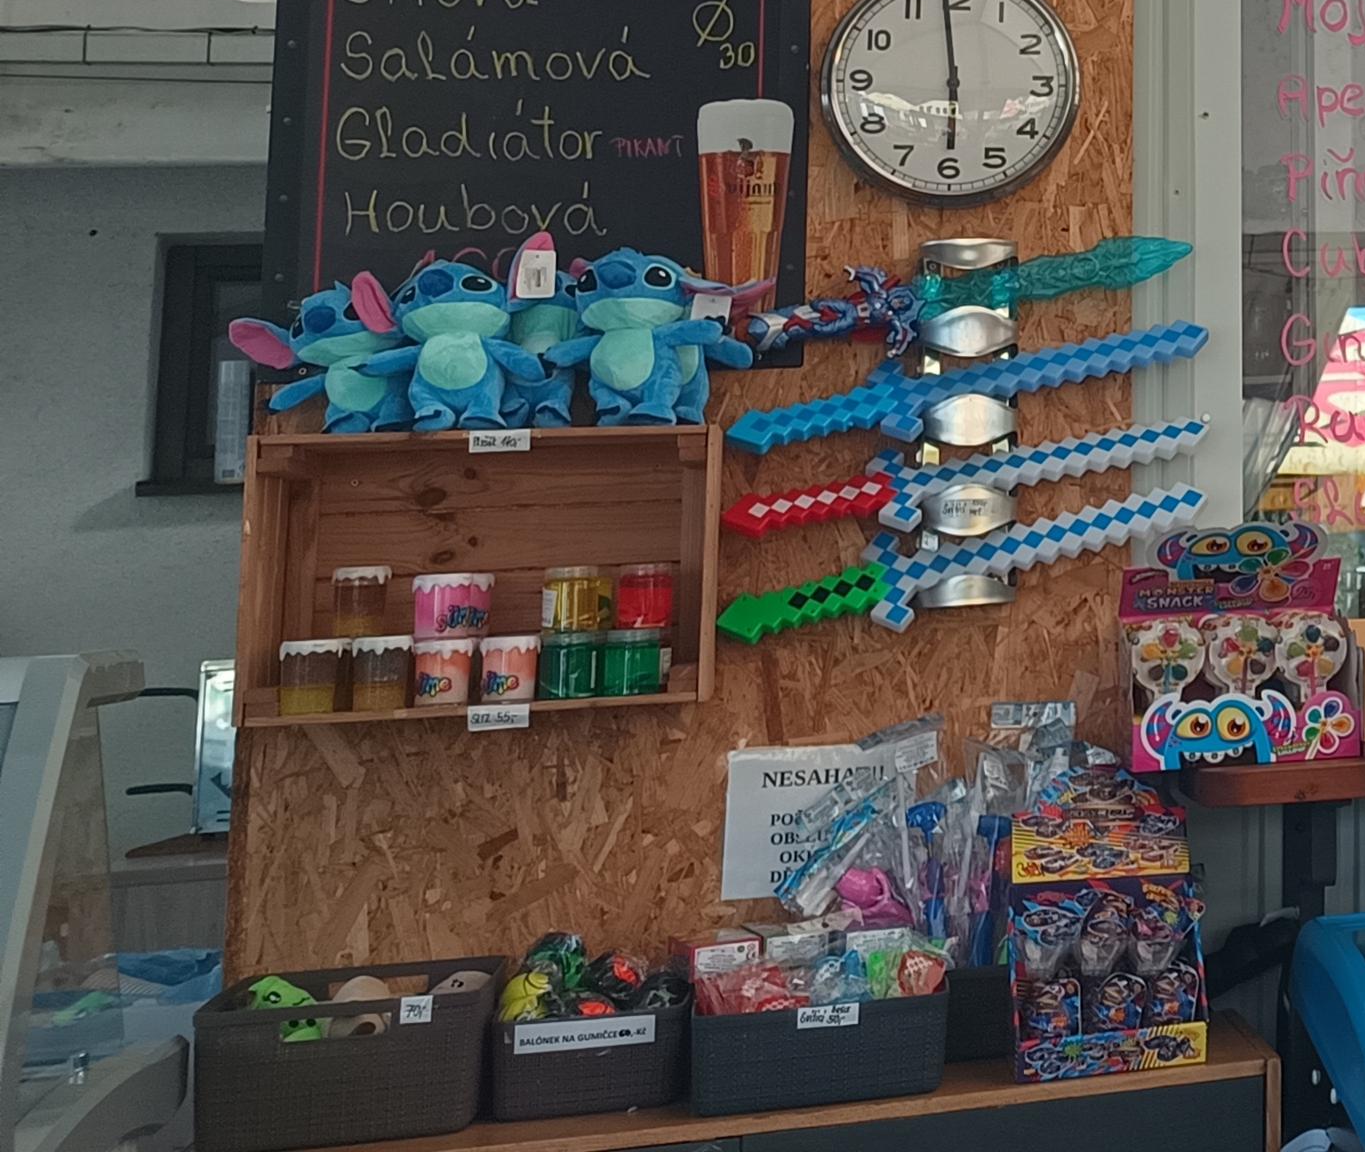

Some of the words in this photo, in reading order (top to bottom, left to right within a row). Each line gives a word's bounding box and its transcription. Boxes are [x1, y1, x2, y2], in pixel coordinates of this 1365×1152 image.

[867, 28, 891, 51] 10
[1018, 33, 1042, 55] 2
[340, 25, 650, 82] Salámová
[849, 69, 873, 91] 9
[1029, 75, 1054, 97] 3
[336, 98, 603, 161] Gladiátor
[609, 134, 684, 160] PIKANT
[859, 112, 886, 134] 8
[1015, 117, 1039, 140] 4
[892, 144, 915, 167] 7
[982, 146, 1007, 169] 5
[936, 158, 961, 180] 6
[345, 181, 609, 237] Houbová
[1280, 314, 1360, 366] Gin
[1147, 596, 1203, 609] SNACK
[518, 1034, 560, 1047] BALÓNEK
[562, 1035, 575, 1044] NA
[577, 1029, 618, 1043] GUMIČCE
